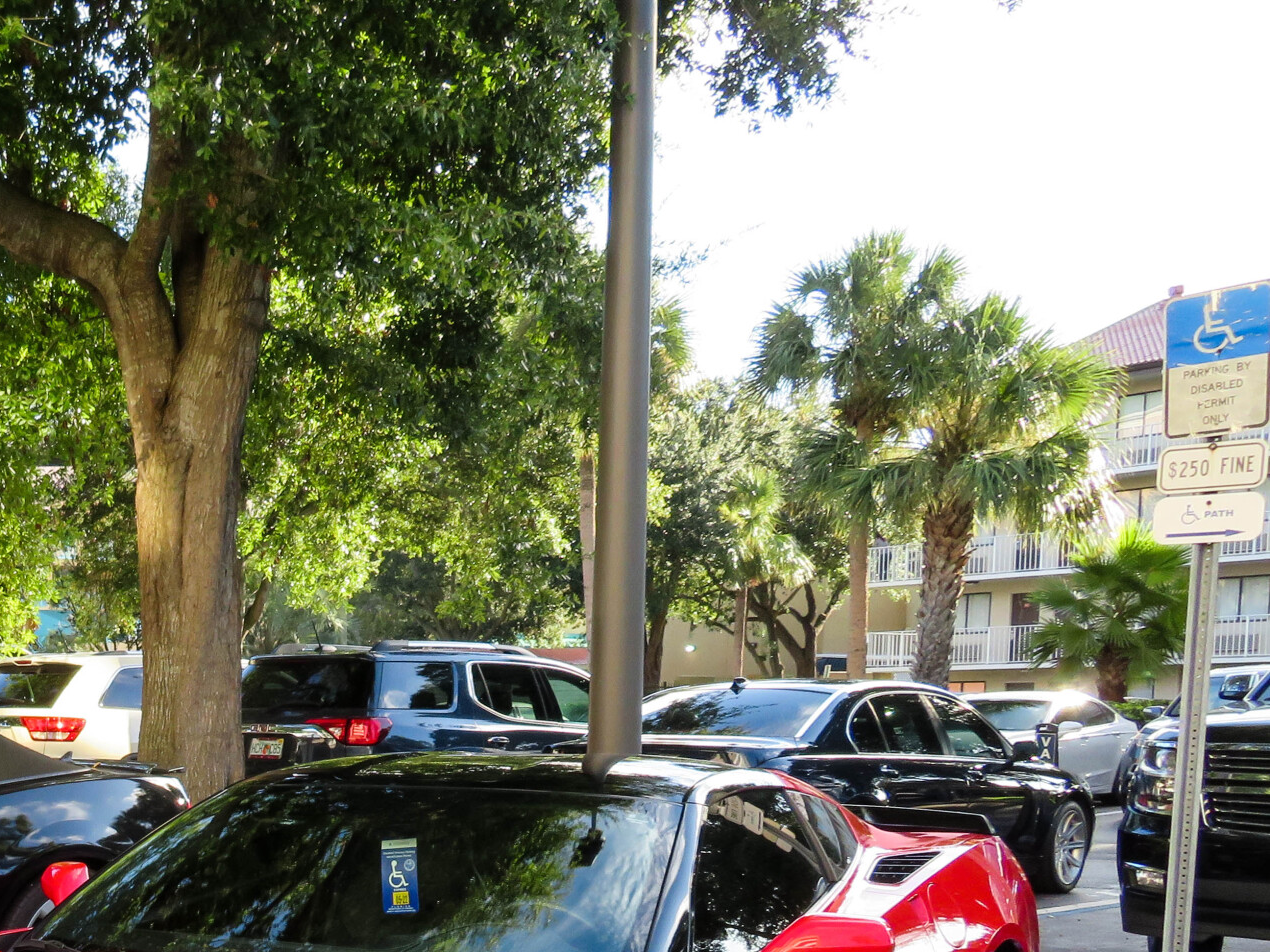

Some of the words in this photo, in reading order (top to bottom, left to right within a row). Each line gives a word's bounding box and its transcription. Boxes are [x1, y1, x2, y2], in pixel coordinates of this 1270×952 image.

[1183, 363, 1229, 379] PARKING
[1236, 361, 1252, 372] BY
[1190, 378, 1243, 394] DISABLED
[1202, 413, 1229, 425] ONLY
[1168, 459, 1210, 478] $250
[1220, 455, 1255, 475] FINE
[1204, 509, 1234, 518] PATH
